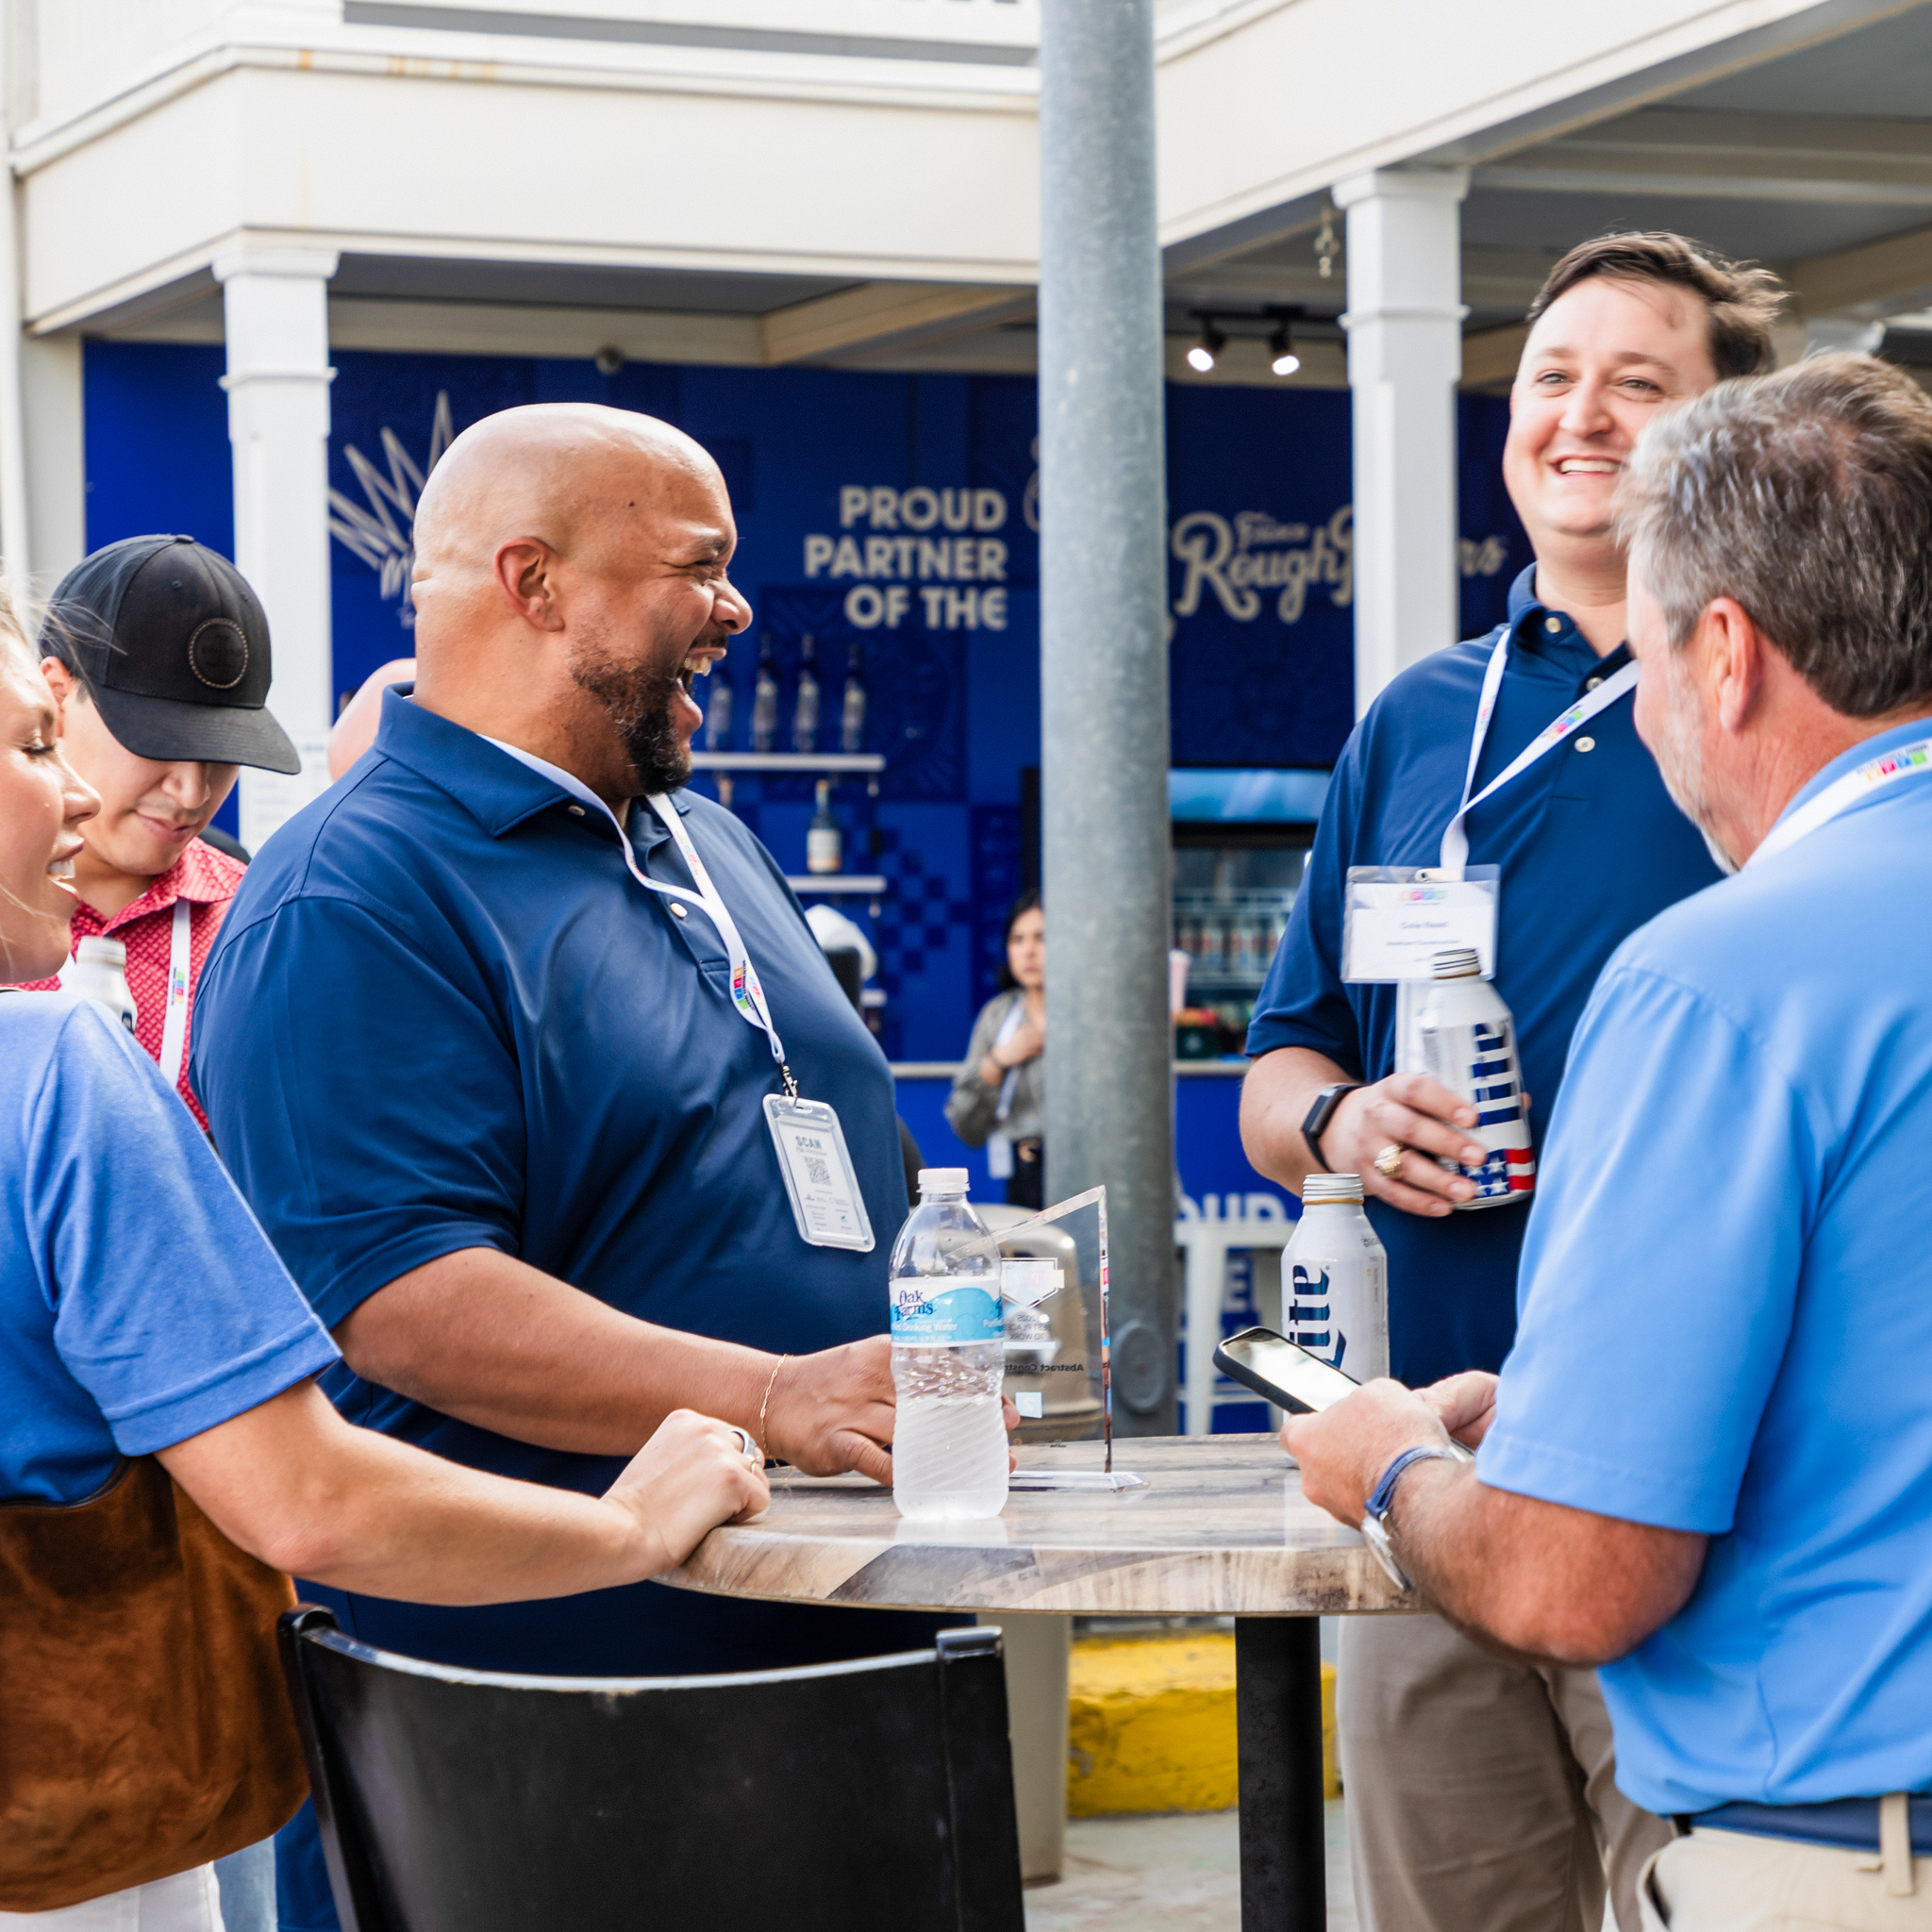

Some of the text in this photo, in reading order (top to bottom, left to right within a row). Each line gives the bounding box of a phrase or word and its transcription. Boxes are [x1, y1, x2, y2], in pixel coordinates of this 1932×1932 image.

[841, 485, 1008, 531] PROUD
[804, 534, 1008, 581] PARTNER
[844, 584, 1008, 631] OF THE
[795, 1136, 823, 1149] SCAN
[899, 1291, 924, 1306] Oak
